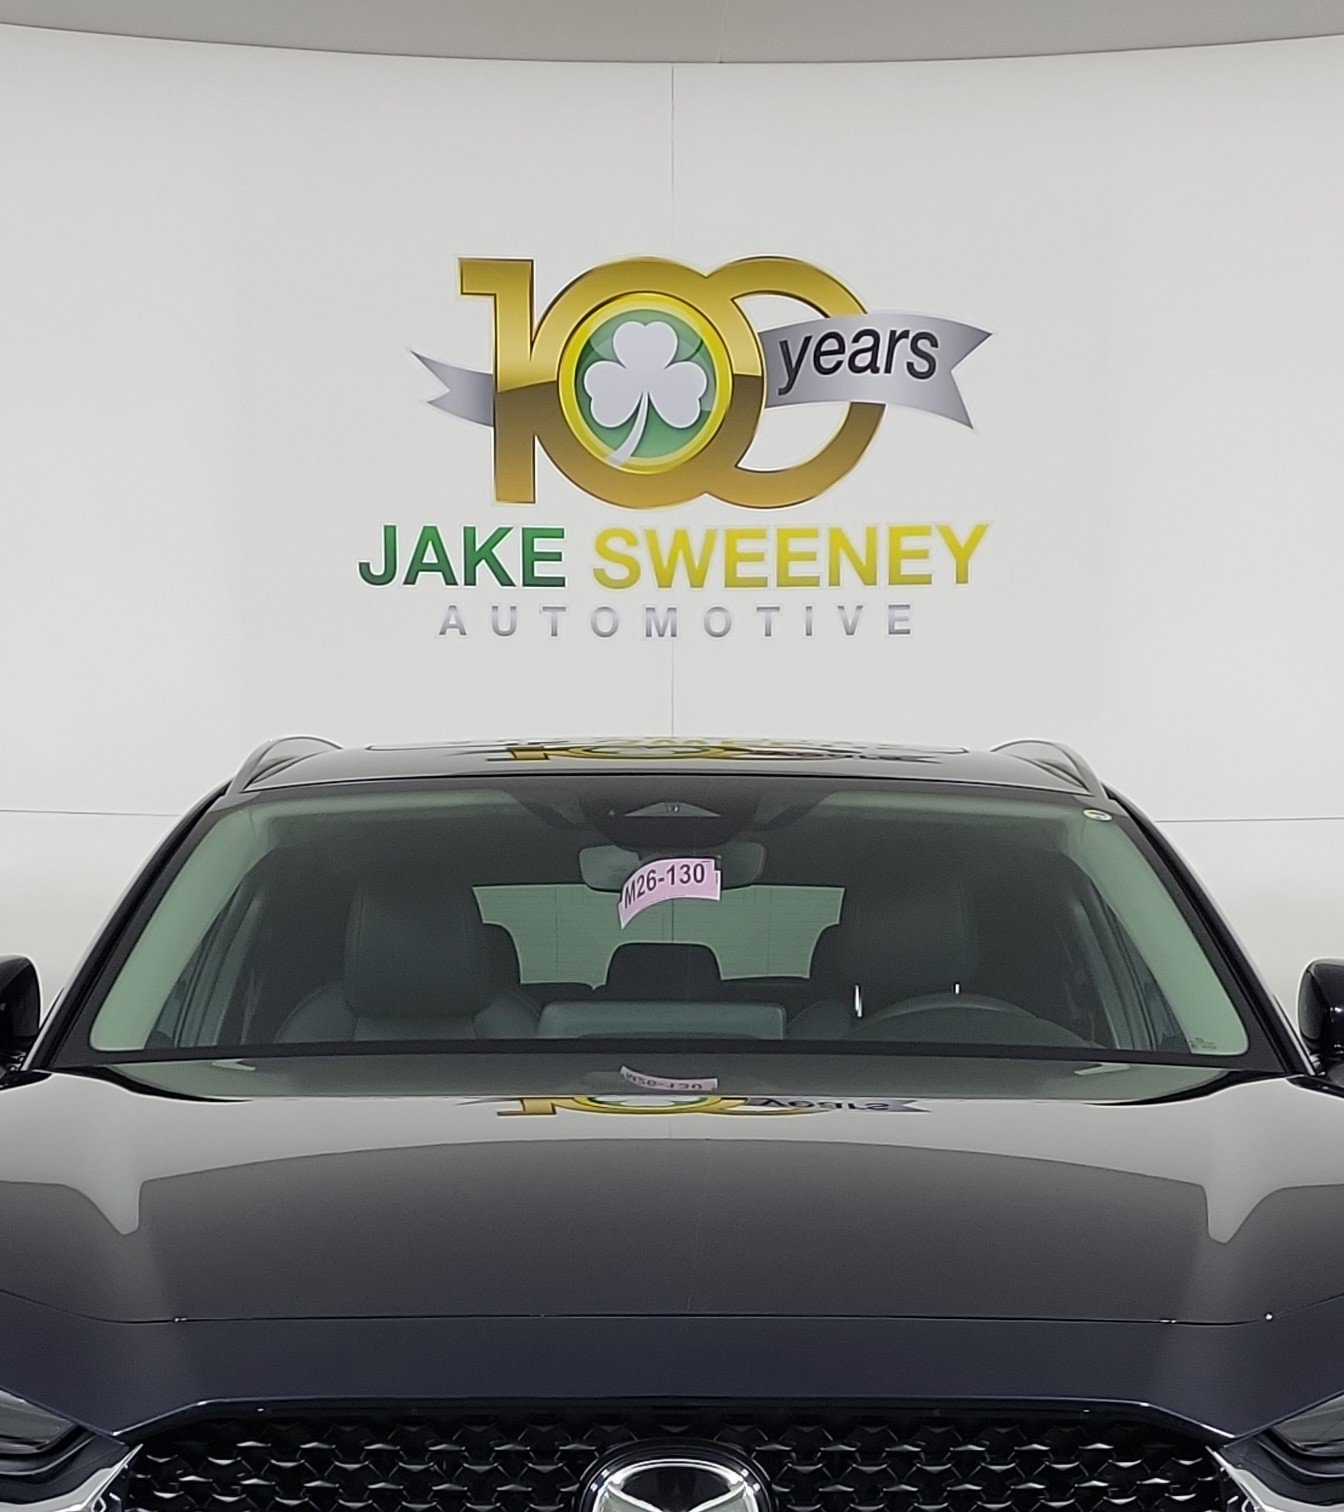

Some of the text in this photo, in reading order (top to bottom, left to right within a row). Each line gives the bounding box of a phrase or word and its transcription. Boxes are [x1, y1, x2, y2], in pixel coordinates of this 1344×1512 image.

[458, 256, 941, 509] 100 years
[357, 522, 989, 590] JAKE SWEENEY
[437, 603, 912, 639] AUTOMOTIVE
[624, 862, 706, 909] M26-130
